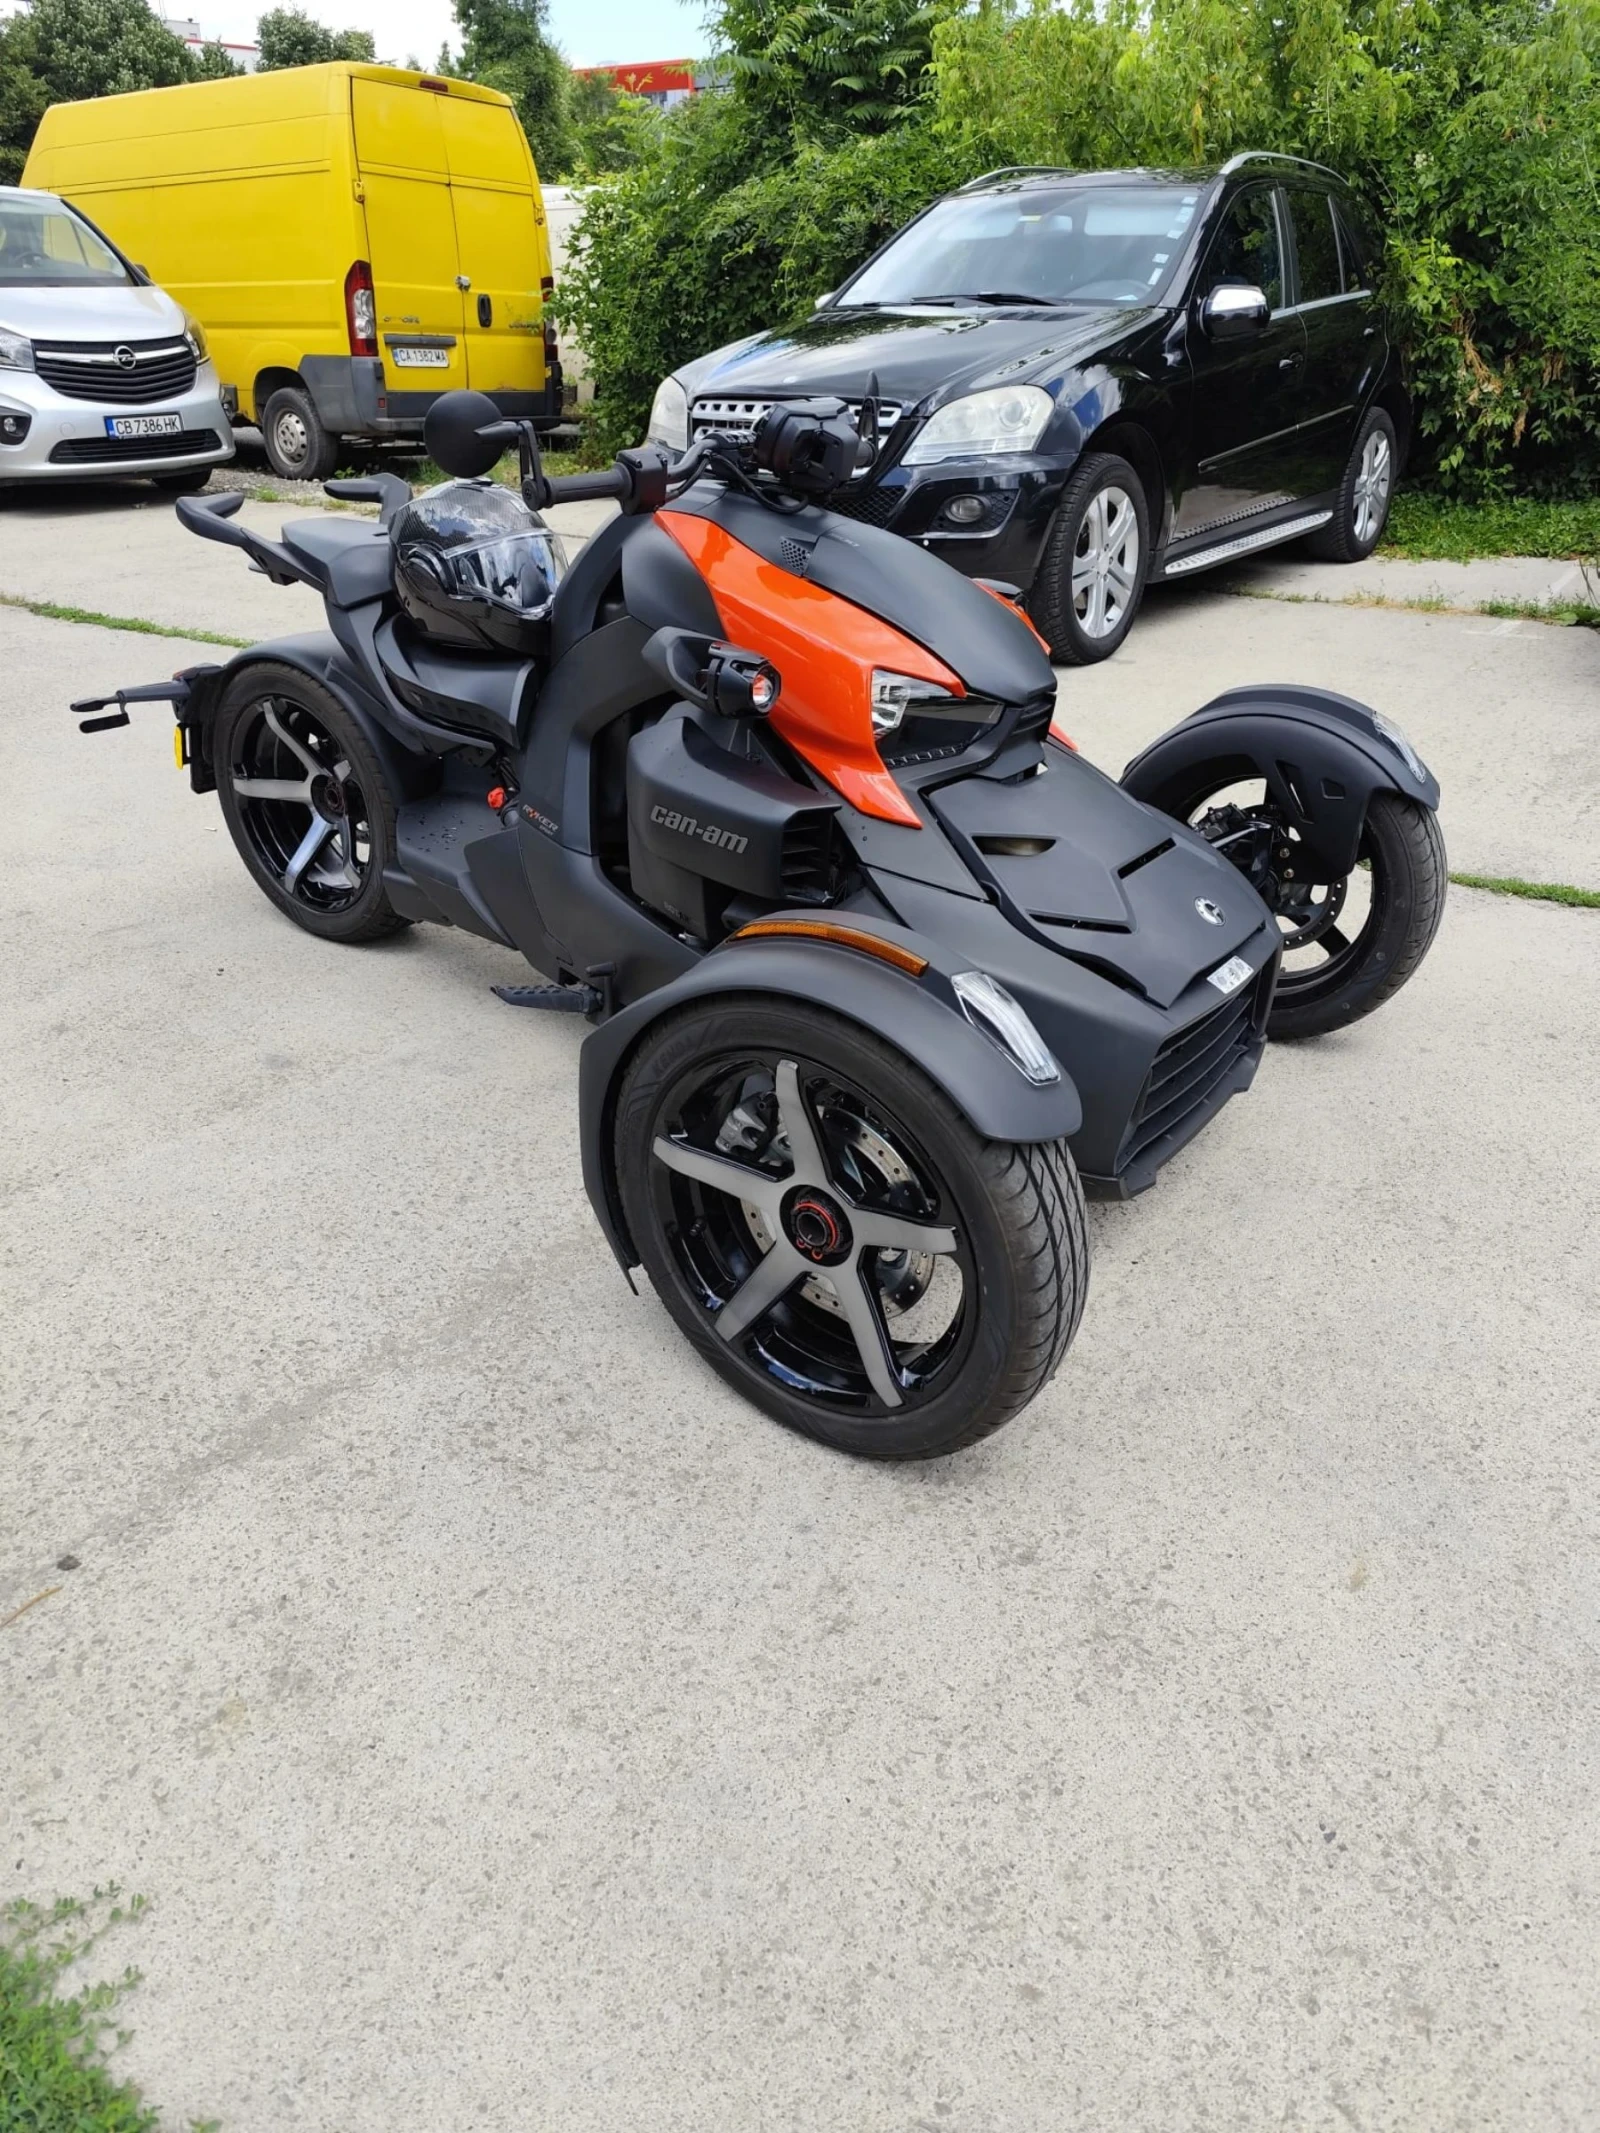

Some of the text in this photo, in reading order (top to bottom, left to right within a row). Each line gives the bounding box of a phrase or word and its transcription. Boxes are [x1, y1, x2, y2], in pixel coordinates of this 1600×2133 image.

[399, 349, 411, 361] CA
[116, 417, 179, 435] CB 7386 HK
[522, 804, 559, 832] RYKER
[650, 804, 749, 854] can-am
